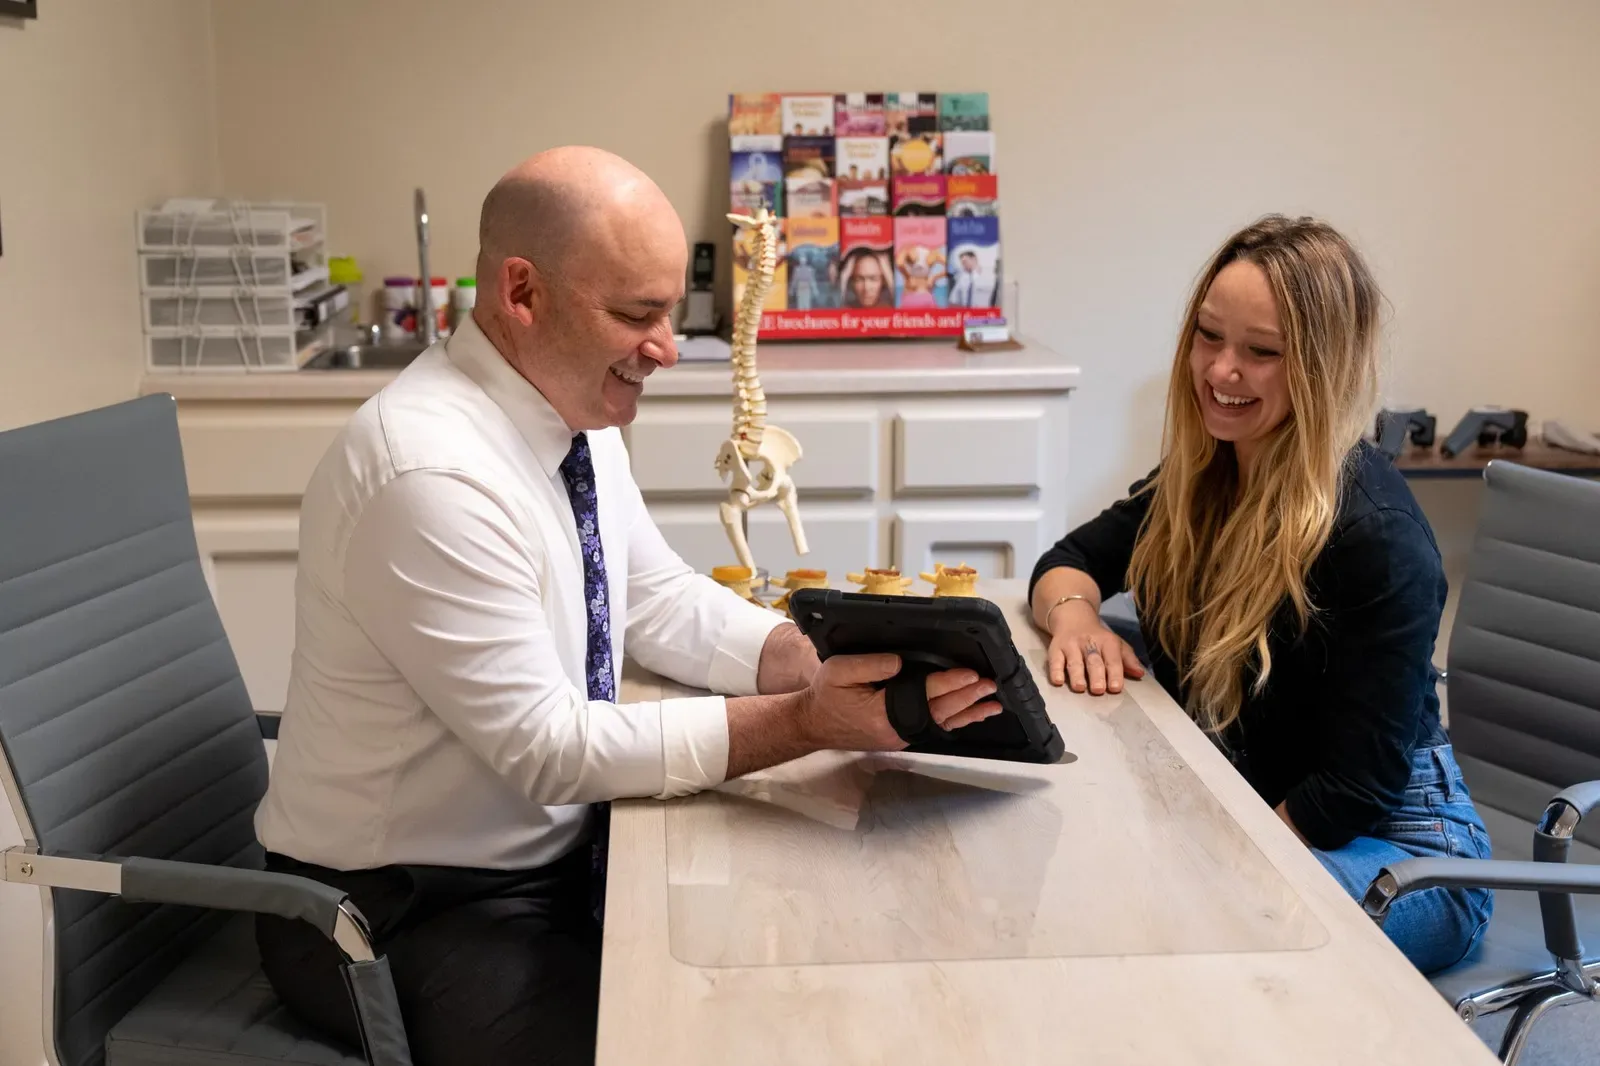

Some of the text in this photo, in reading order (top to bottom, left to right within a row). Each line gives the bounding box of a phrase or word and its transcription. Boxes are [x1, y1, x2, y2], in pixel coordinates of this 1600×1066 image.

[777, 313, 840, 330] brochures
[841, 312, 860, 329] for
[861, 315, 890, 333] your
[893, 311, 936, 329] friends
[938, 312, 961, 329] and
